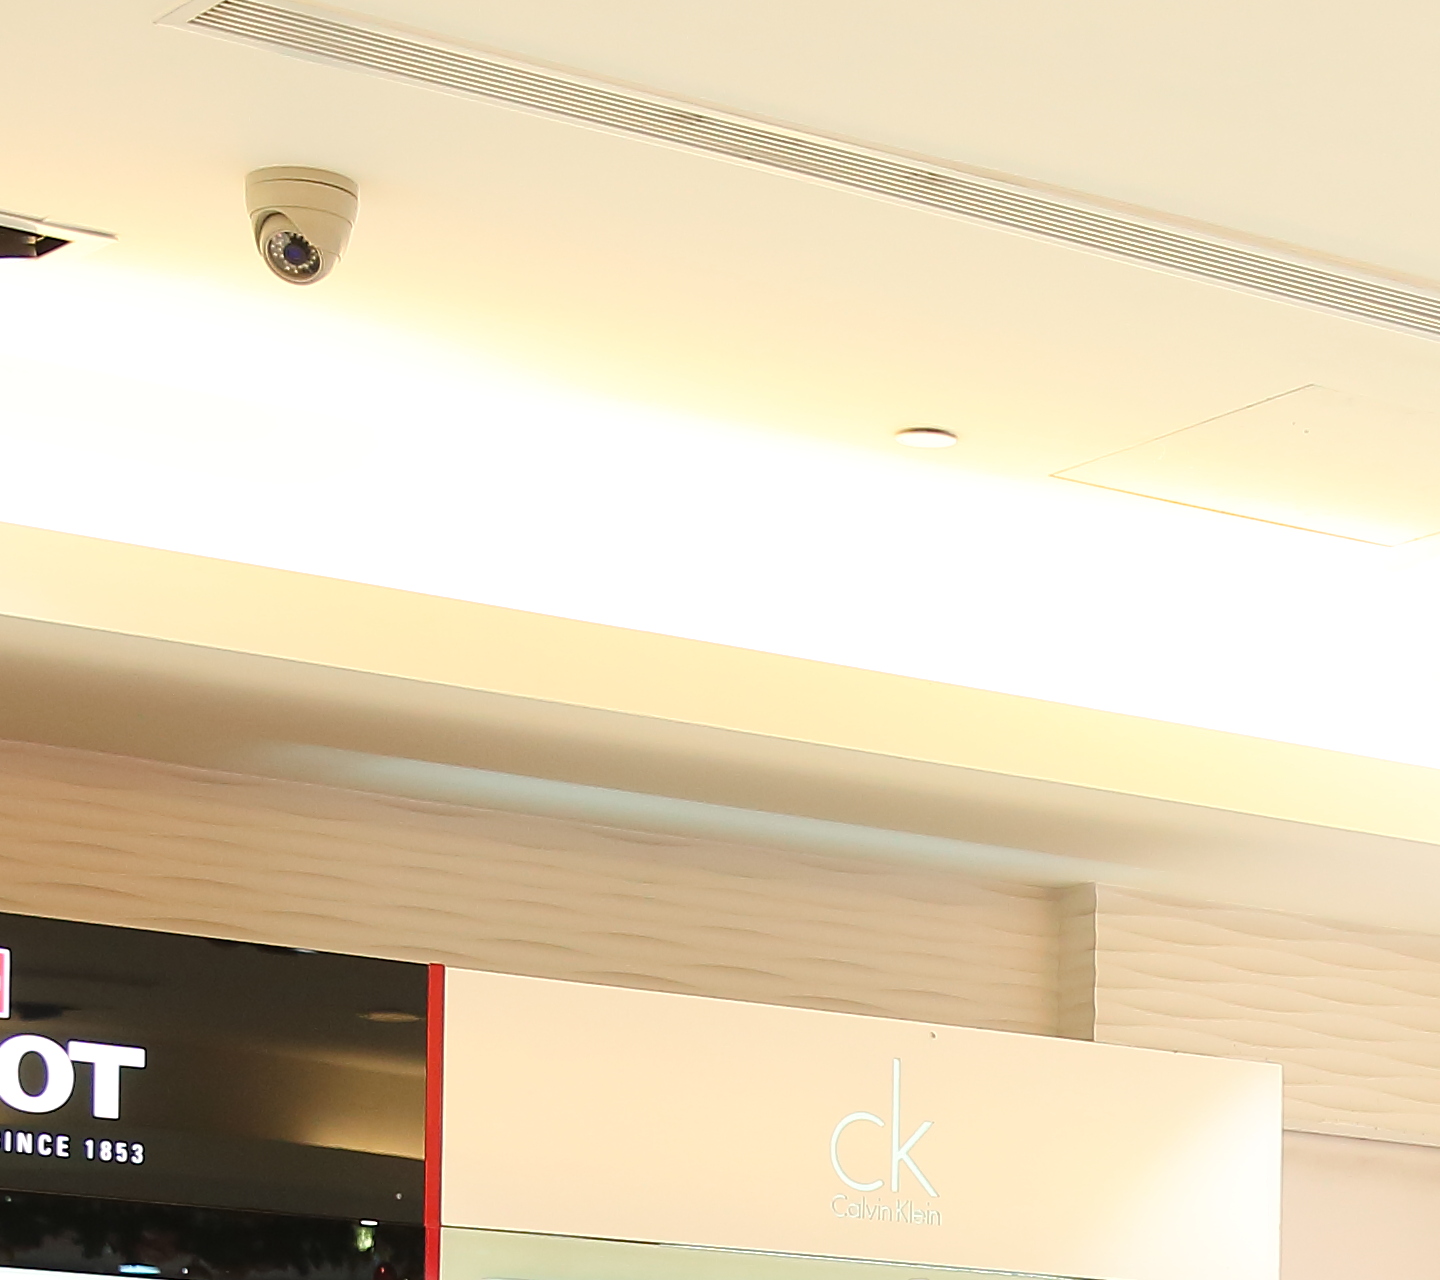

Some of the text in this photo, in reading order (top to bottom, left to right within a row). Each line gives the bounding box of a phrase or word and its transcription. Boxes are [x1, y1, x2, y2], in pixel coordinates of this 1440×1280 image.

[830, 1057, 940, 1198] ck
[83, 1138, 145, 1165] 1853
[831, 1195, 943, 1227] Calvin Klein
